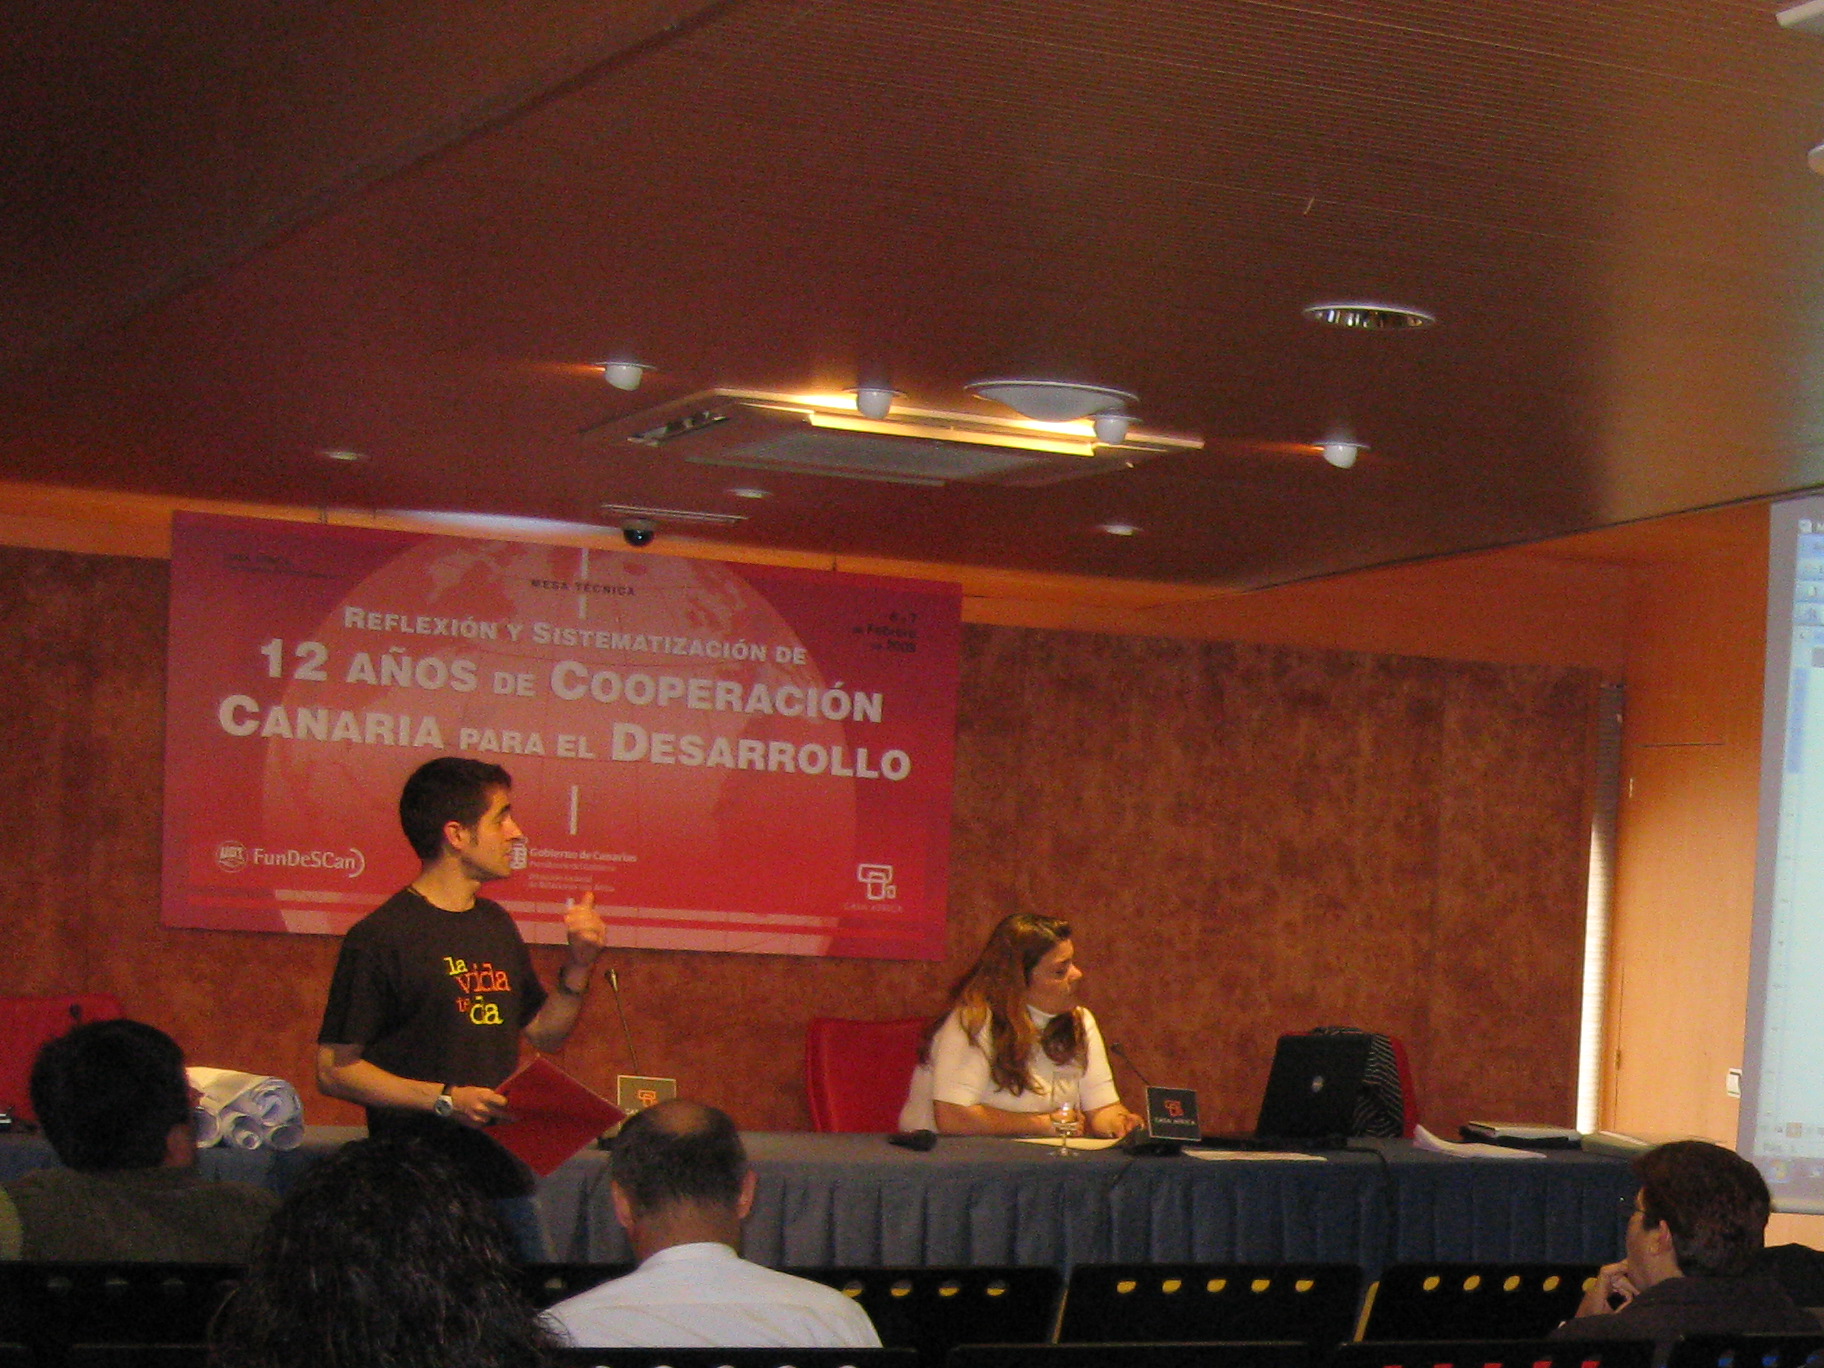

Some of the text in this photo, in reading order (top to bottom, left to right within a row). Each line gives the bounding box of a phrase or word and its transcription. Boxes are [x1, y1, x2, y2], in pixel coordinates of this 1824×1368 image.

[531, 579, 568, 590] MESA
[345, 606, 807, 666] REFLEXIÓN Y SISTEMATIZACIÓN DE
[261, 638, 883, 723] 12 AÑOS DE COOPERACIÓN
[219, 694, 911, 782] CANARIA PARA EL DESARROLLO
[443, 956, 468, 976] la
[455, 963, 512, 994] vida
[469, 995, 505, 1025] da
